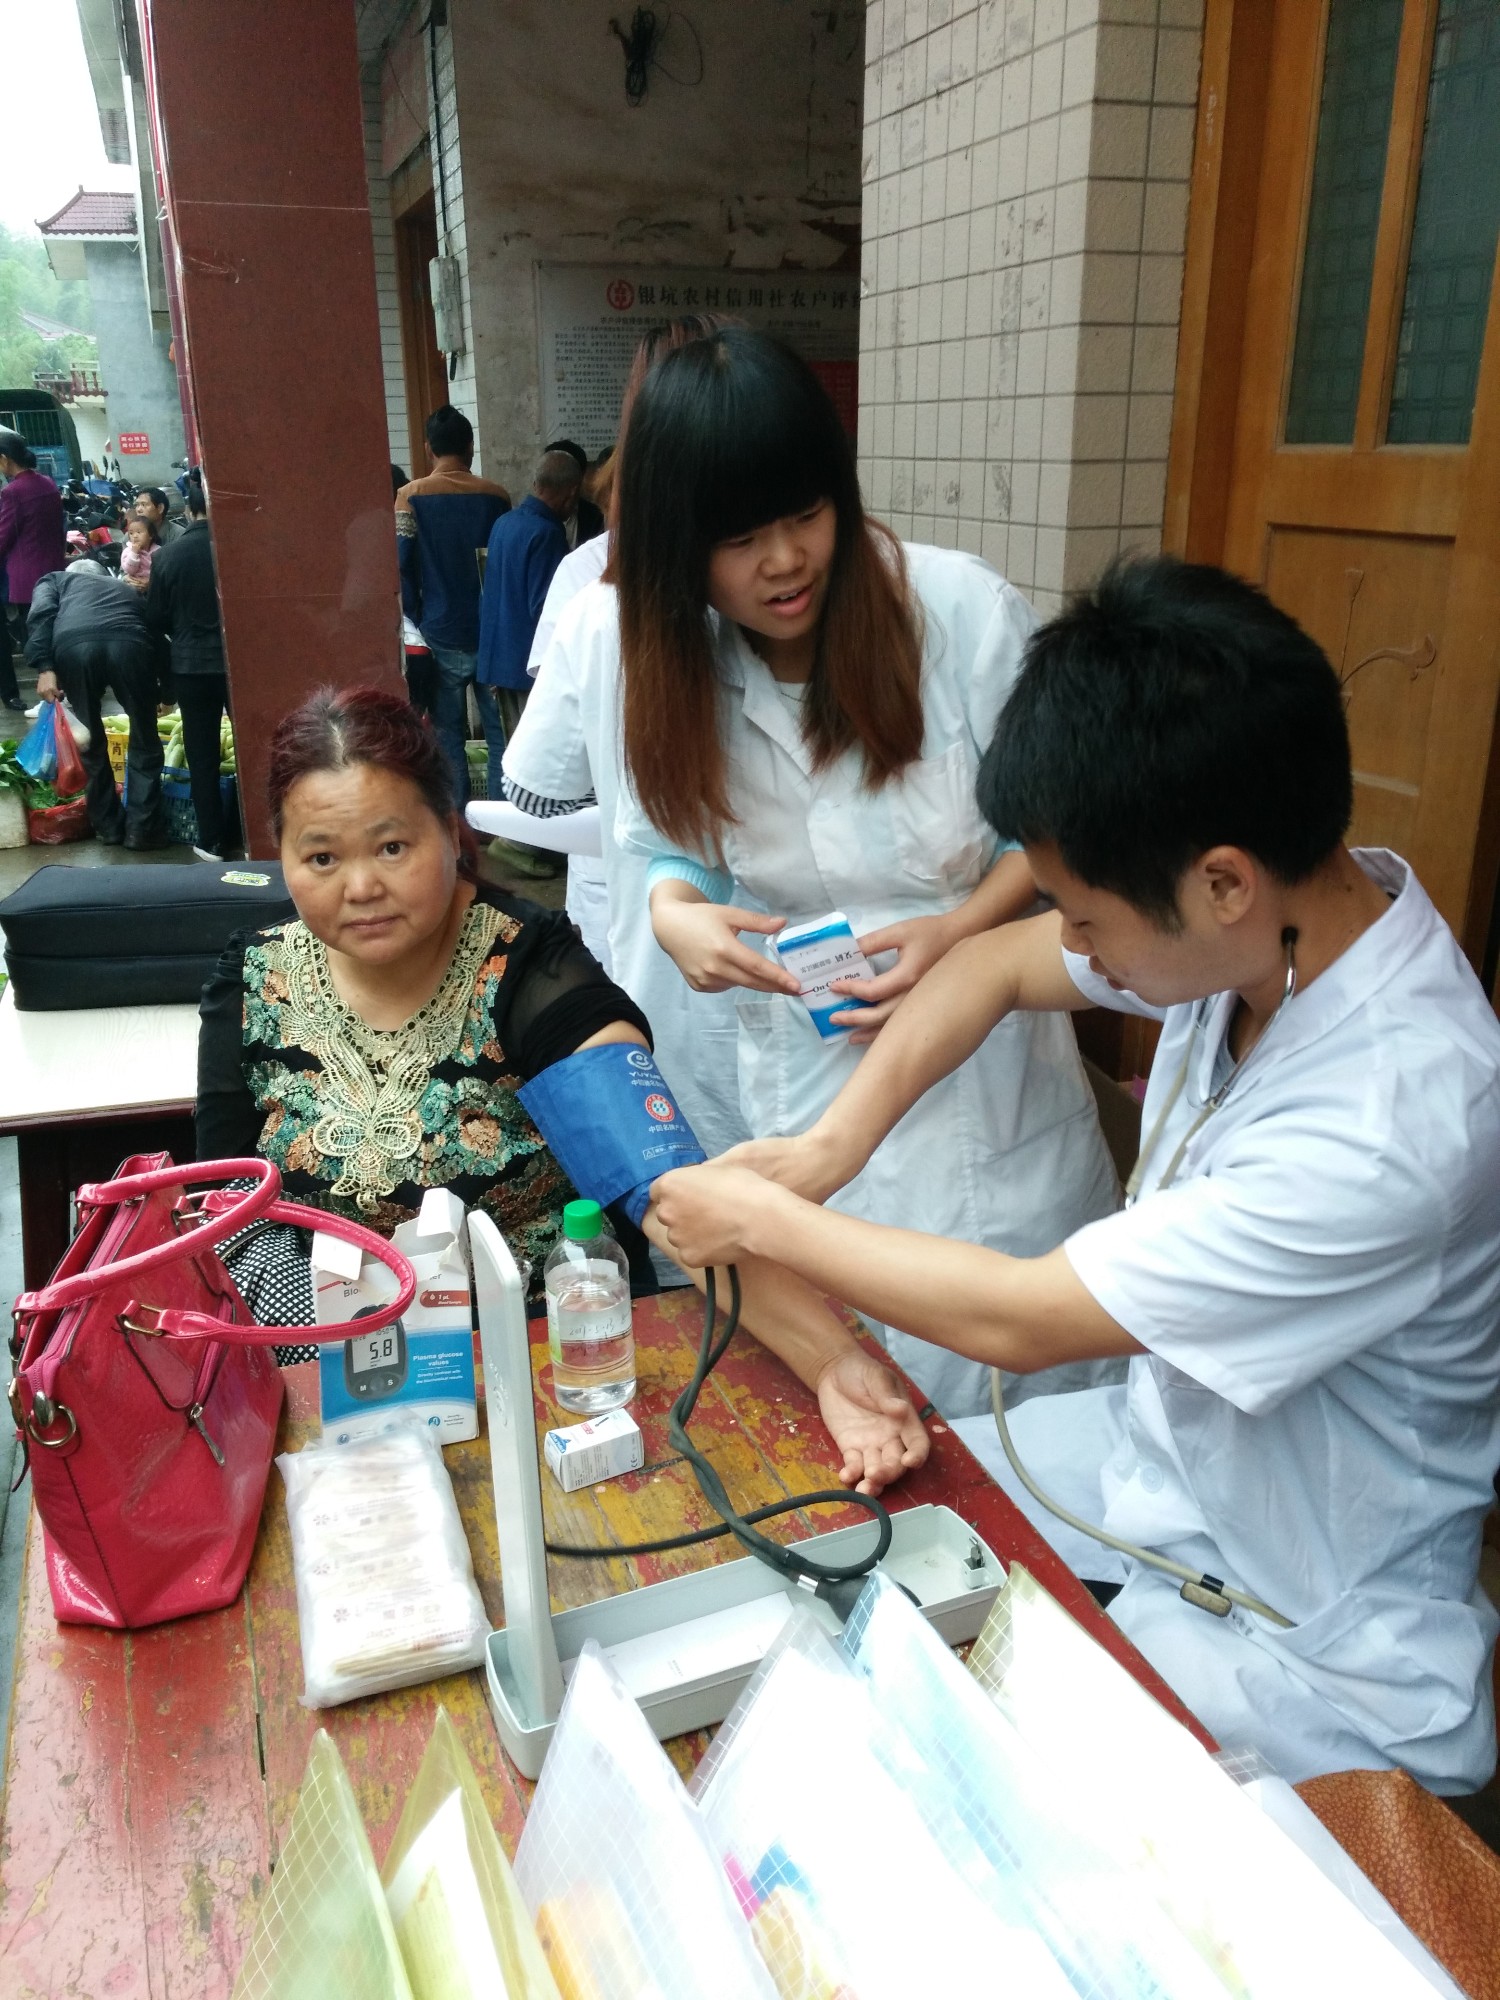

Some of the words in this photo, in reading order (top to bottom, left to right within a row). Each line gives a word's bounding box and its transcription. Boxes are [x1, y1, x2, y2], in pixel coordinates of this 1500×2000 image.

[845, 972, 860, 980] Plus
[370, 1339, 392, 1360] 5.8
[360, 1384, 367, 1392] M
